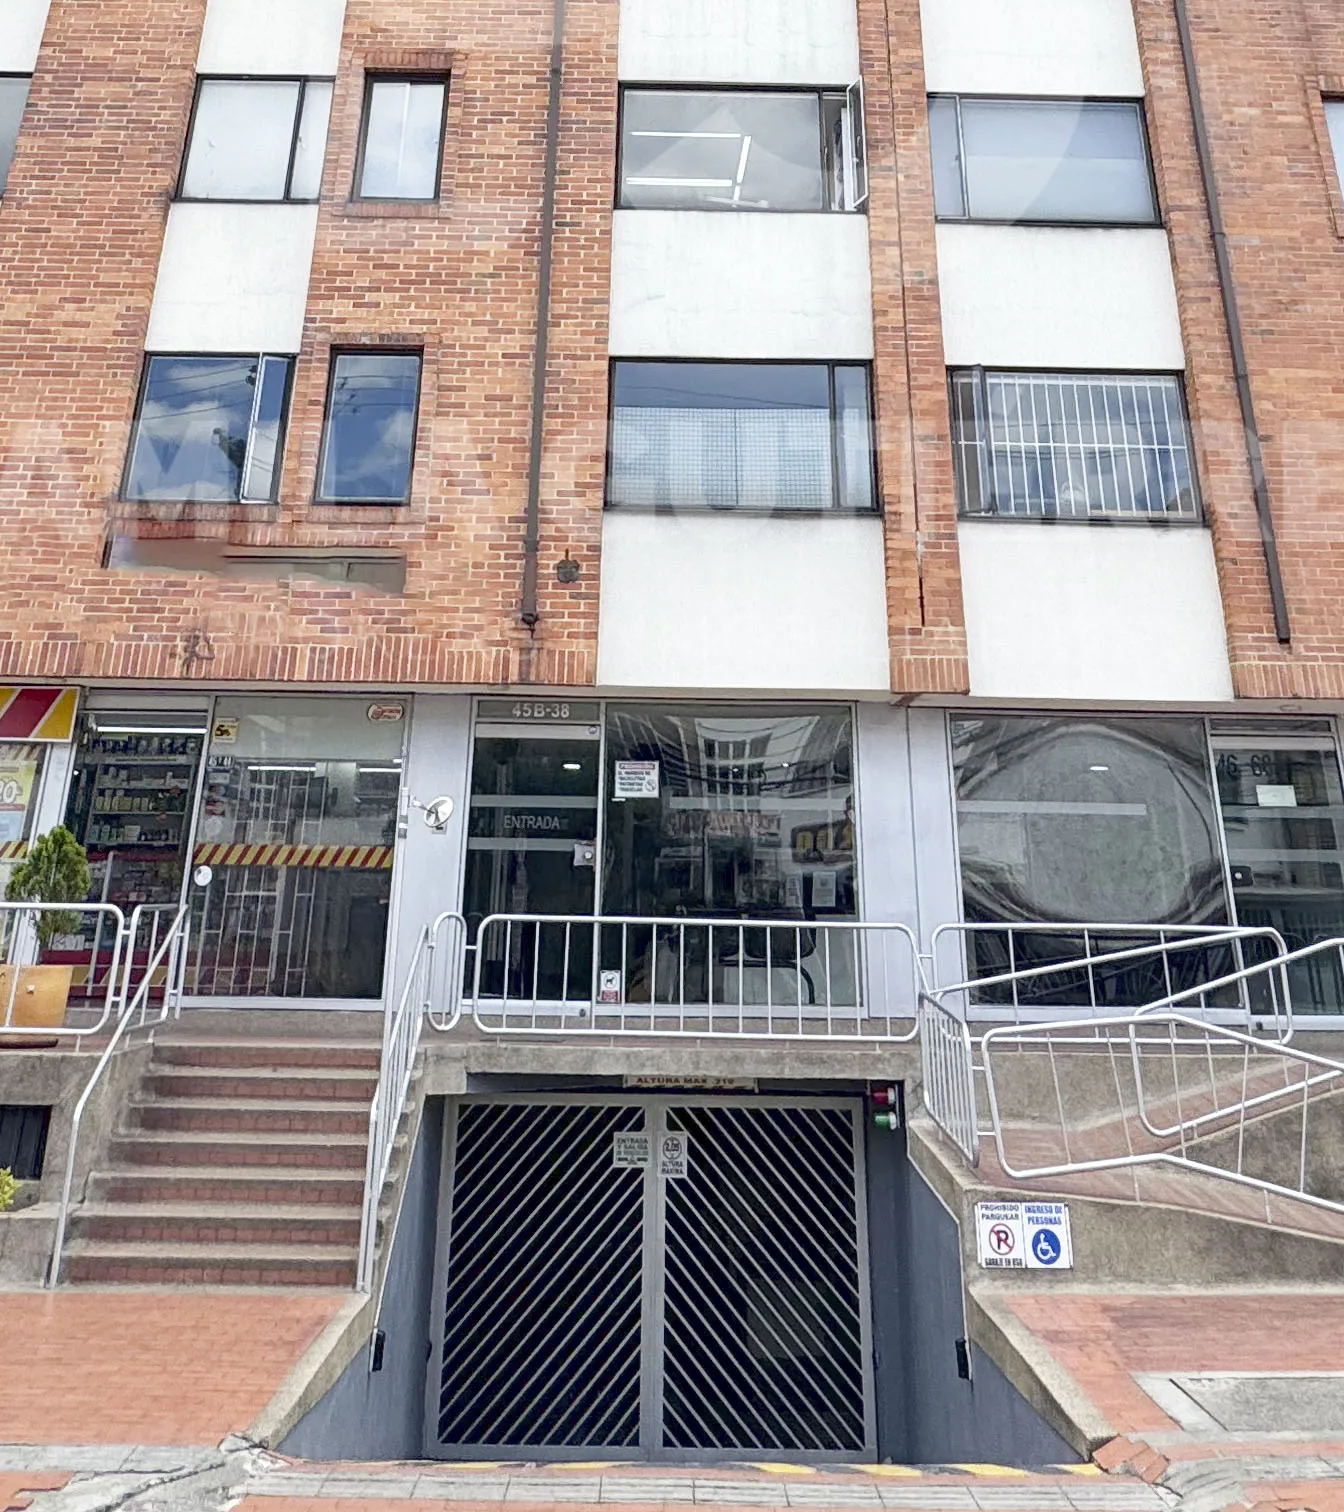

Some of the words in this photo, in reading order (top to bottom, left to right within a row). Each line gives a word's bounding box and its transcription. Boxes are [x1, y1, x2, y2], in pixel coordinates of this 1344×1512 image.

[512, 703, 570, 718] 45B-38
[504, 815, 560, 829] ENTRADA
[636, 1077, 681, 1085] ALTURA
[1028, 1216, 1062, 1225] PERSONAS
